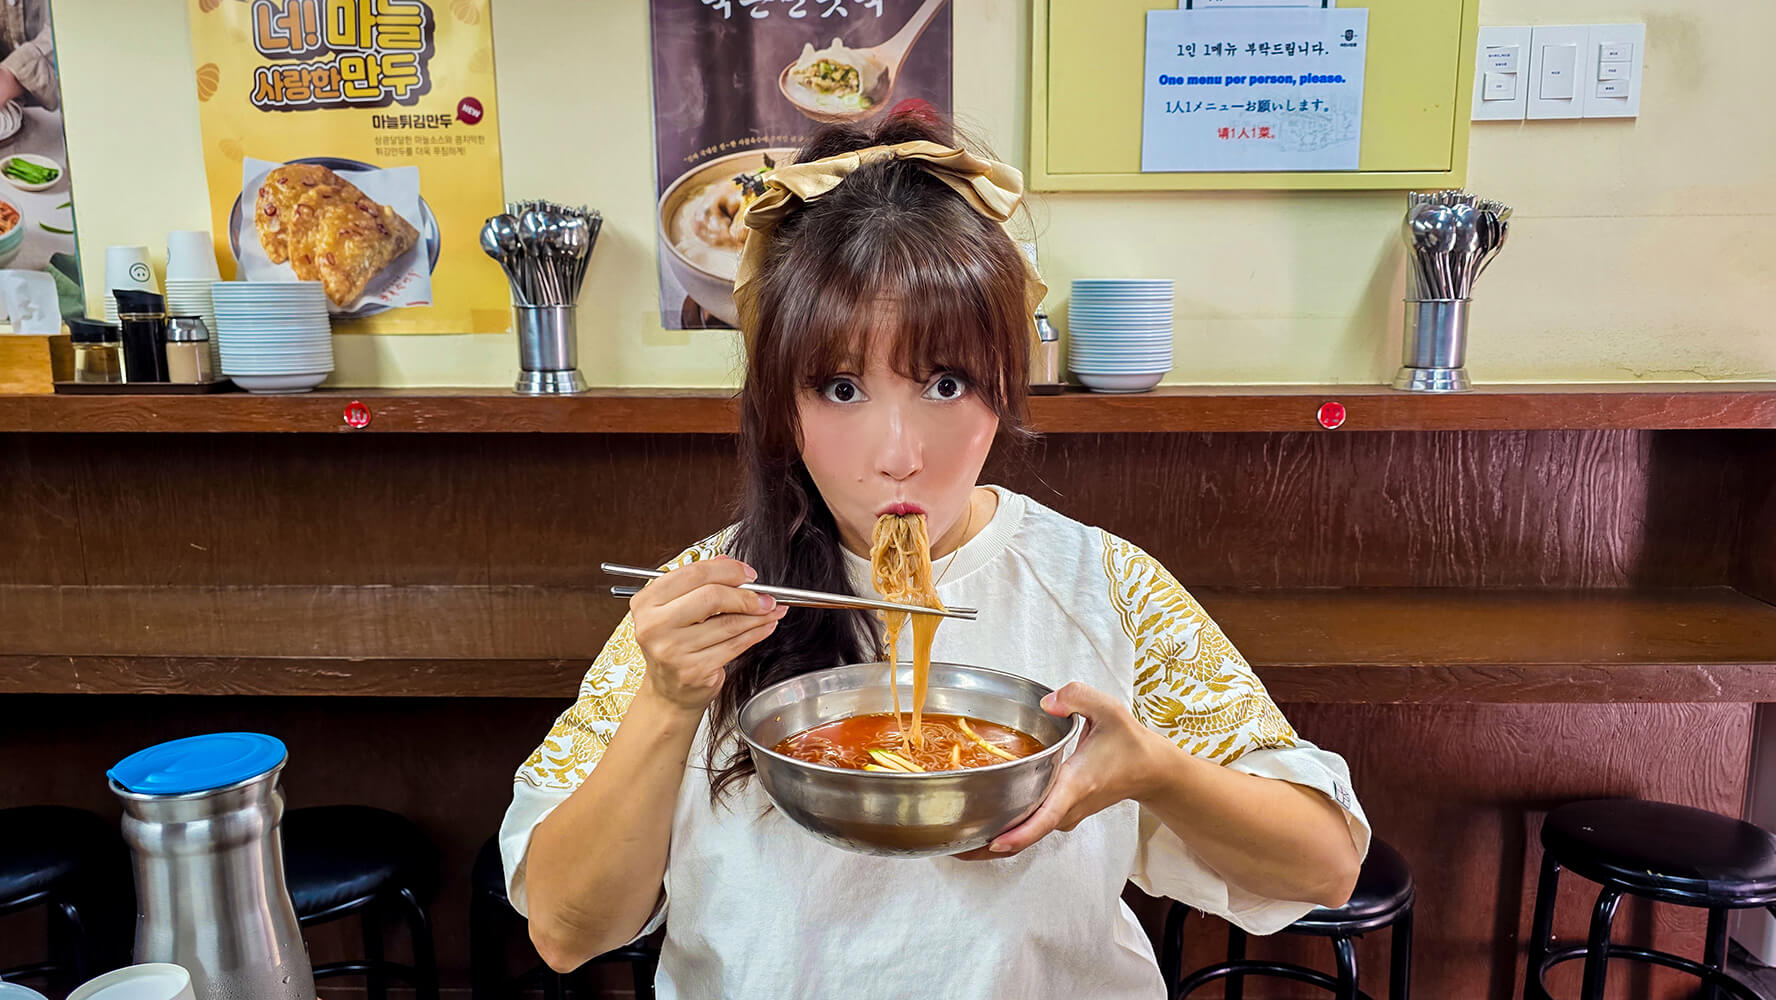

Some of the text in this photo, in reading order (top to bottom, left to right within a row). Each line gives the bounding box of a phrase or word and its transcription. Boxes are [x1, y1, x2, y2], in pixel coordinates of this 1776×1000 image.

[258, 0, 424, 50] 너! 마늘
[1176, 41, 1329, 57] 1인 1메뉴 부탁드립니다.
[1158, 73, 1346, 87] One menu per person, please.
[462, 104, 481, 118] NEW
[1165, 98, 1329, 114] 1人1メニューお願いします。
[372, 114, 453, 129] 마늘튀김만두
